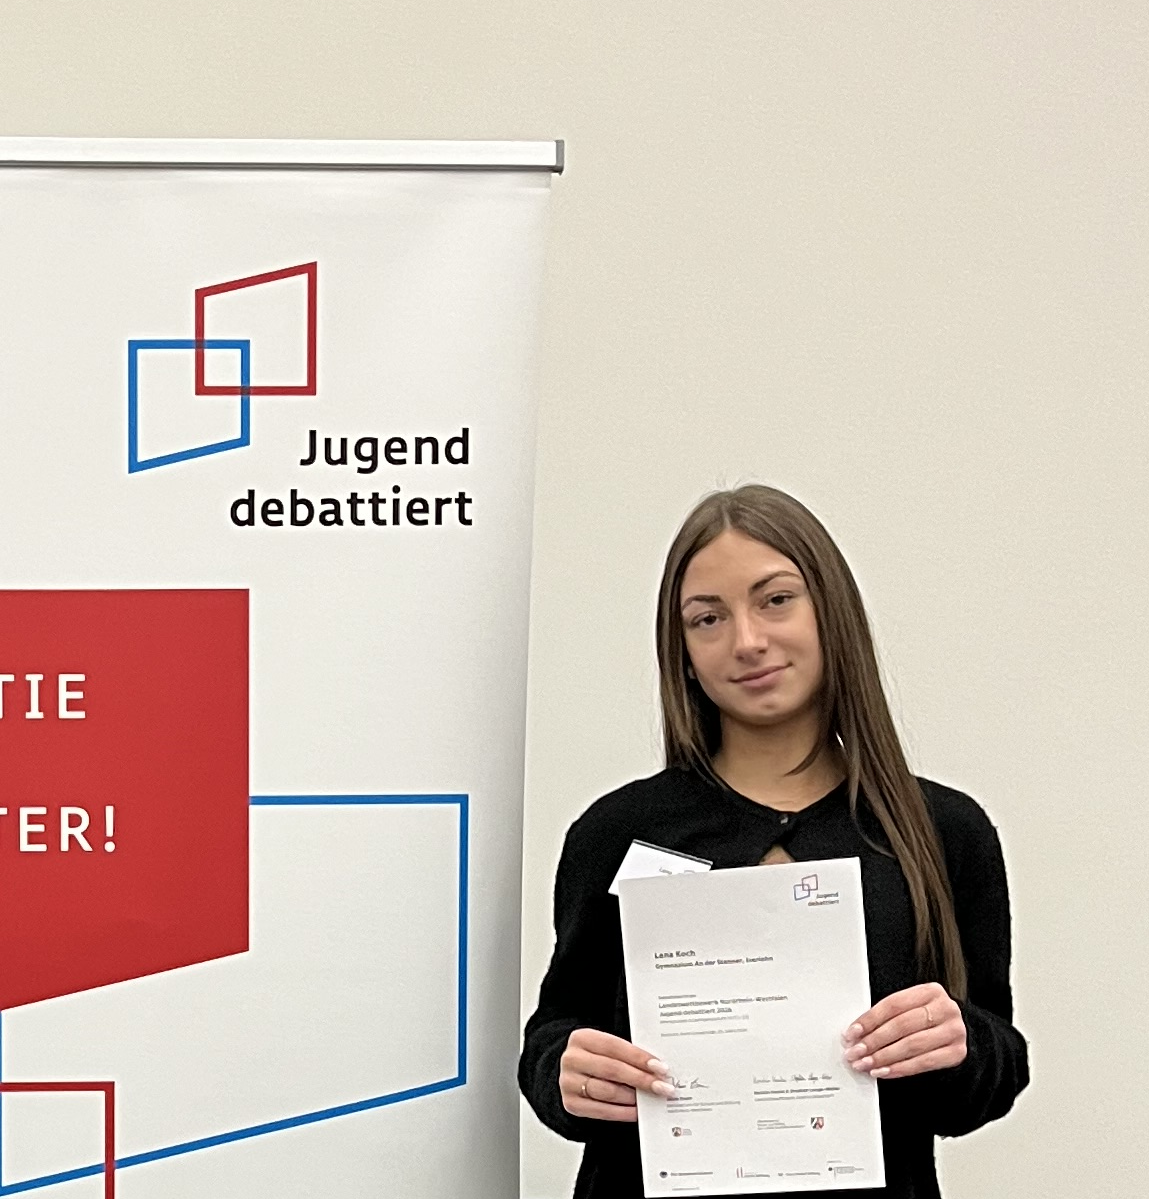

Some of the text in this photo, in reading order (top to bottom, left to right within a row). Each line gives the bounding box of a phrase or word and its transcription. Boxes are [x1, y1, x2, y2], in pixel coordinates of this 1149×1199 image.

[300, 428, 469, 474] Jugend
[230, 485, 472, 527] debattiert
[676, 950, 696, 958] Koch
